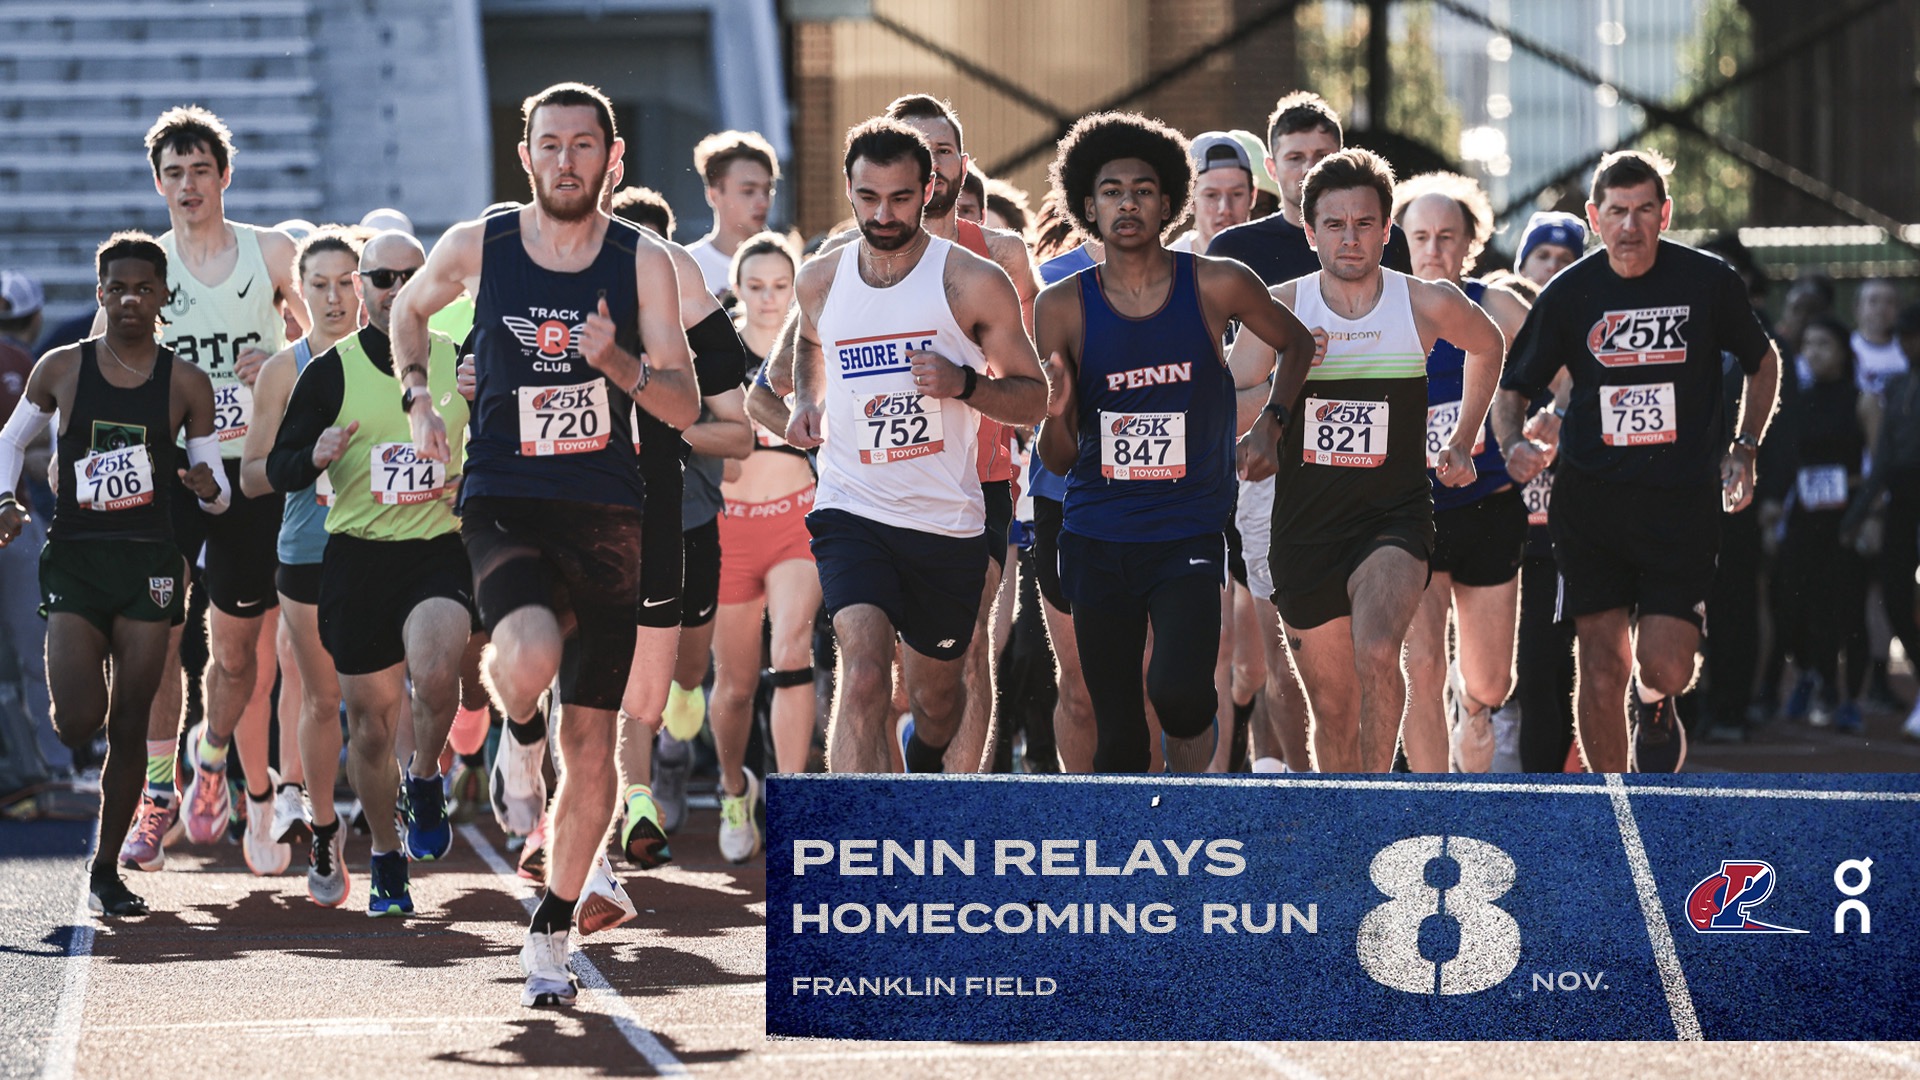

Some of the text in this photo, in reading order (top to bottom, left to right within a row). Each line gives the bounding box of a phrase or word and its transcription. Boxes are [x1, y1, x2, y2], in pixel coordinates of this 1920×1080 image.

[529, 307, 579, 320] TRACK
[544, 326, 563, 347] R
[1328, 330, 1381, 341] saucony
[839, 343, 899, 370] SHORE
[532, 361, 571, 373] CLUB
[207, 371, 233, 379] RACK
[1106, 361, 1192, 391] PENN
[536, 410, 598, 439] 720
[1613, 408, 1664, 432] 753
[219, 428, 247, 439] OYOTA
[868, 416, 930, 448] 752
[1630, 434, 1664, 443] TOYOTA
[557, 440, 599, 451] TOYOTA
[1317, 425, 1371, 453] 821
[890, 446, 930, 458] TOYOTA
[1114, 439, 1172, 465] 847
[1335, 455, 1373, 464] TOYOTA
[384, 465, 435, 491] 714
[1133, 469, 1172, 477] TOYOTA
[89, 471, 142, 502] 706
[108, 496, 144, 509] TOYOTA
[400, 492, 433, 502] TOYOTA
[724, 503, 746, 517] KE
[749, 499, 791, 518] PRO
